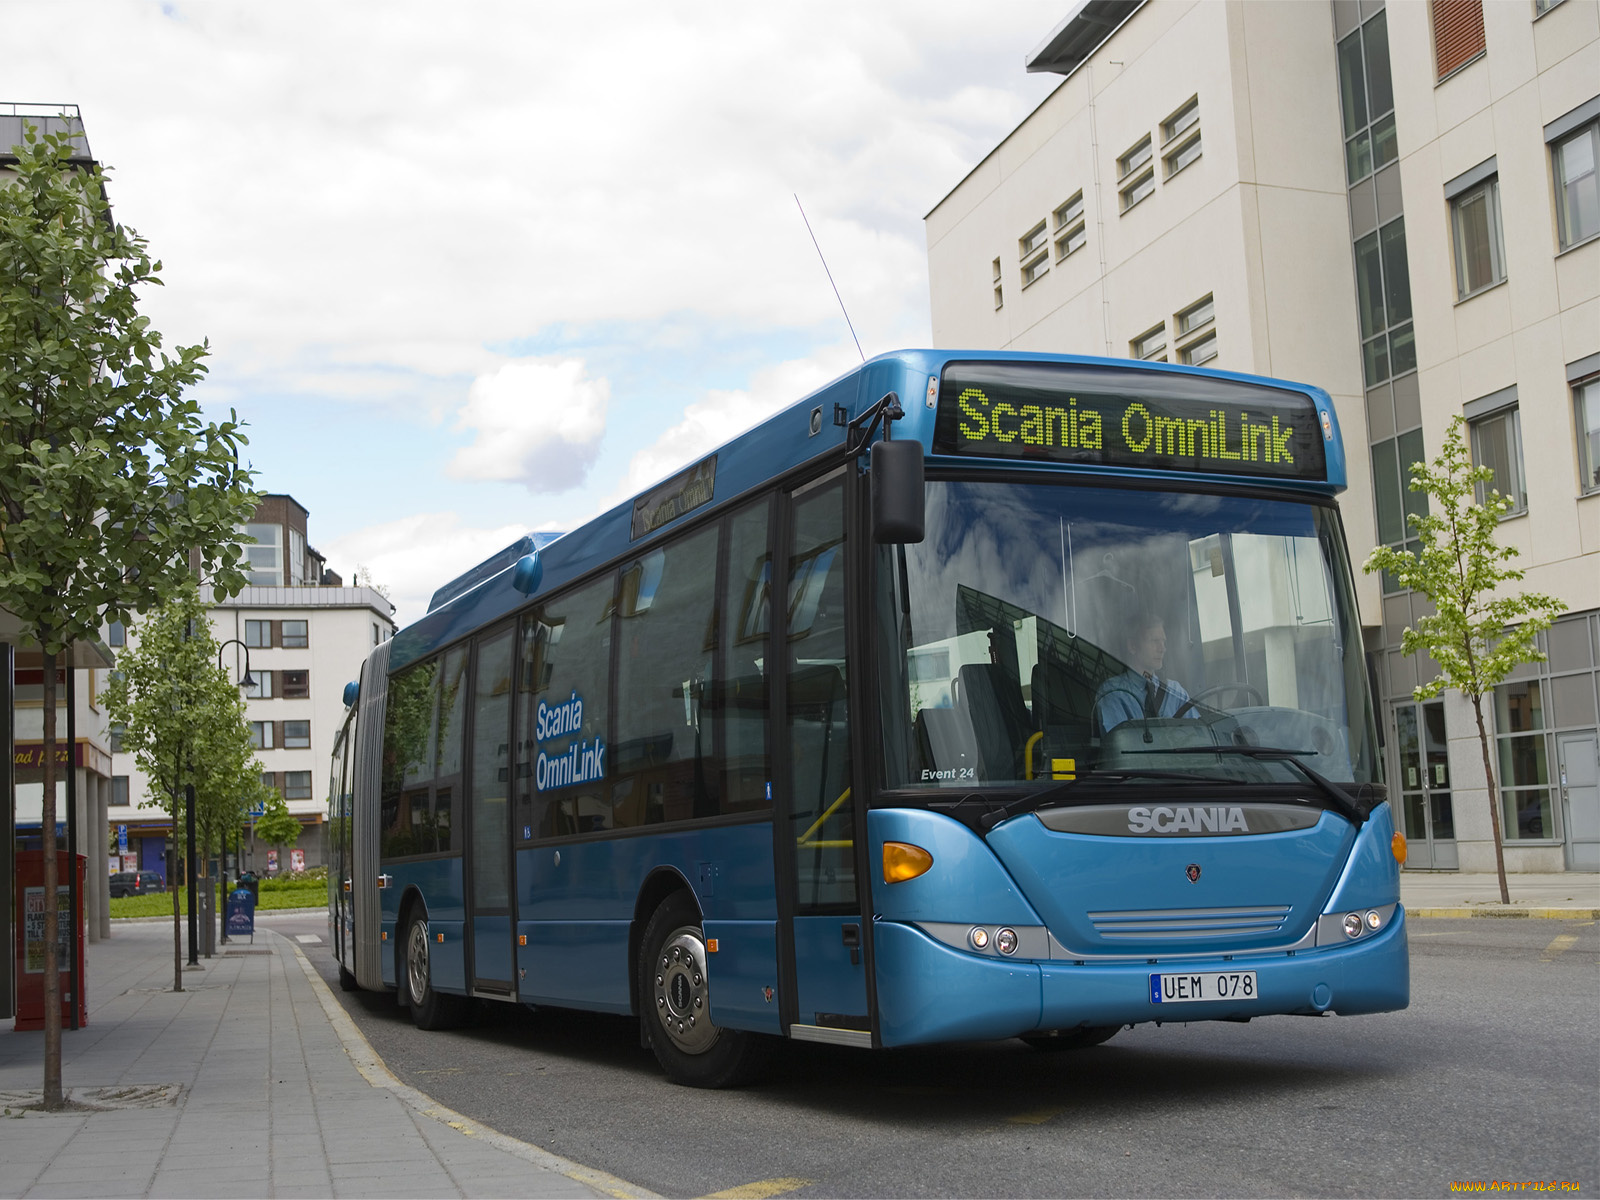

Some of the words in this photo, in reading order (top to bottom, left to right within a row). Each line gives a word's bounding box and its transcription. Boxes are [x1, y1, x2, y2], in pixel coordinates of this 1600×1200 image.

[959, 388, 1103, 450] Scania
[1121, 402, 1294, 464] OmniLink
[536, 692, 583, 741] Scania
[536, 738, 604, 791] OmniLink
[921, 768, 956, 780] Event
[959, 767, 974, 778] 24
[1127, 806, 1250, 833] SCANIA
[1164, 976, 1202, 999] UEM
[1217, 974, 1253, 997] 078
